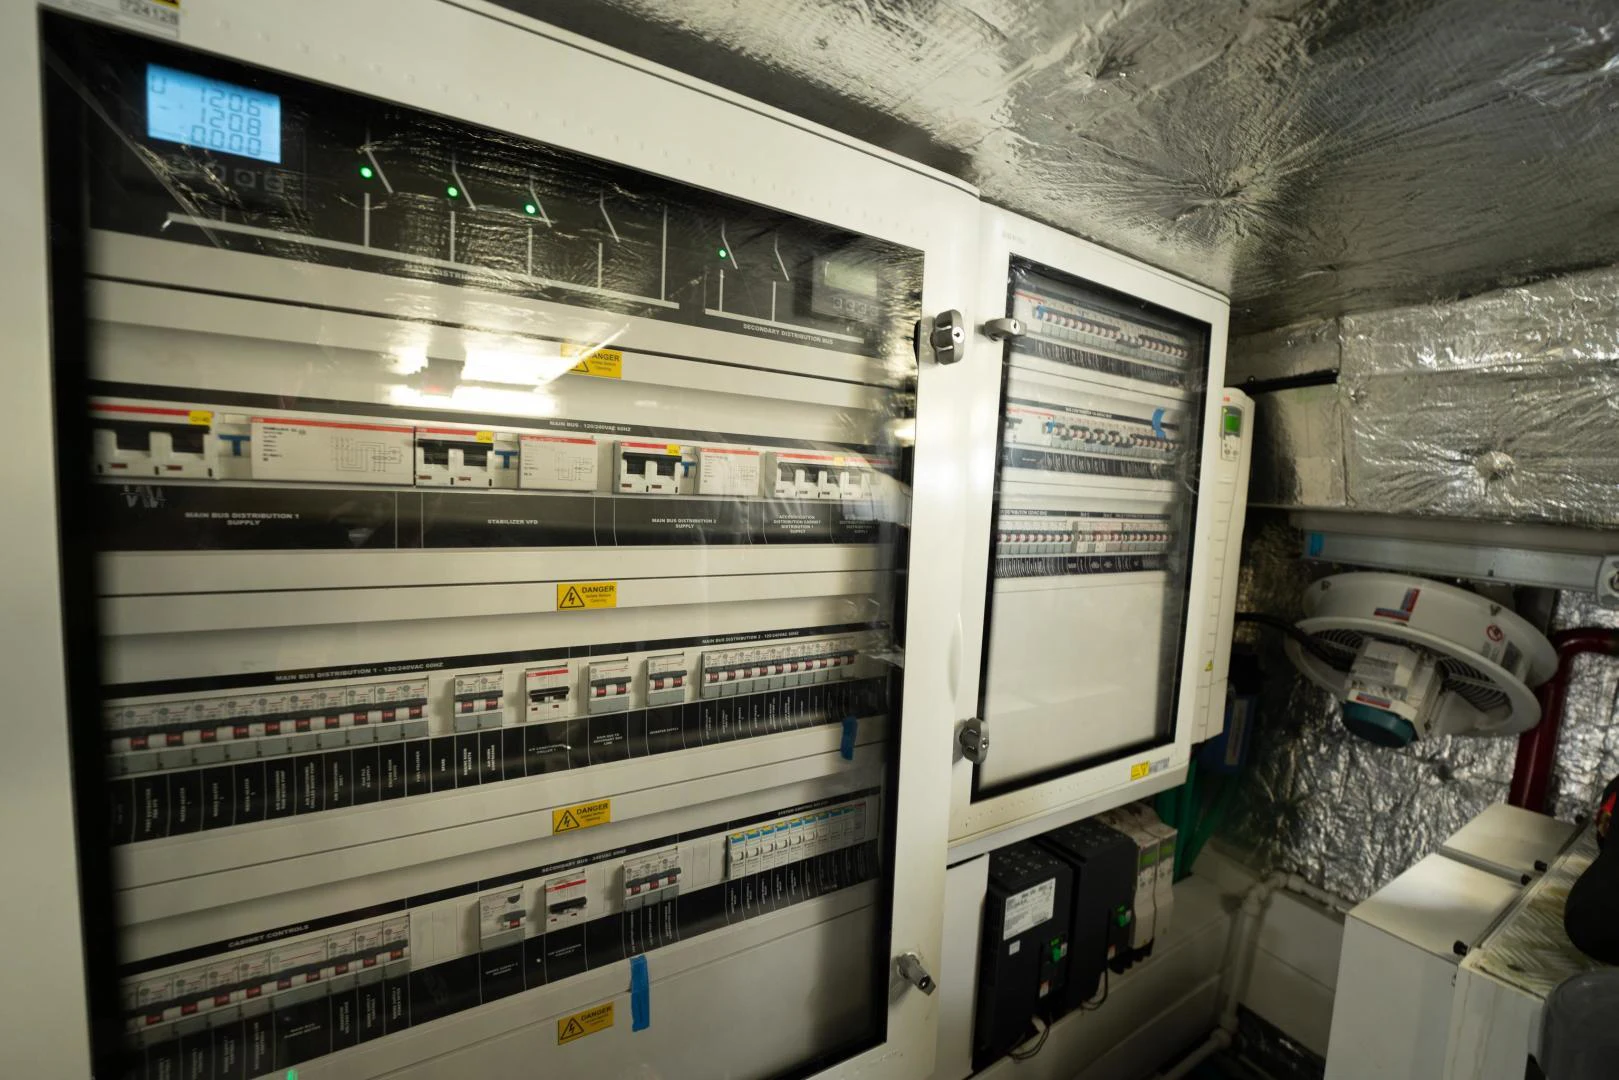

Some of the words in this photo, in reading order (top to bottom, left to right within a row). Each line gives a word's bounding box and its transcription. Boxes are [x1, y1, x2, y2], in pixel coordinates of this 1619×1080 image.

[743, 324, 780, 335] SECONDARY
[781, 330, 822, 342] DISTRIBUTION
[590, 352, 620, 362] ANGER
[582, 585, 614, 593] DANGER
[317, 669, 371, 678] DISTRIBUTION
[576, 802, 608, 814] DANGER
[228, 935, 265, 948] CABINET
[267, 924, 310, 938] CONTROLS
[581, 1006, 612, 1021] DANGER
